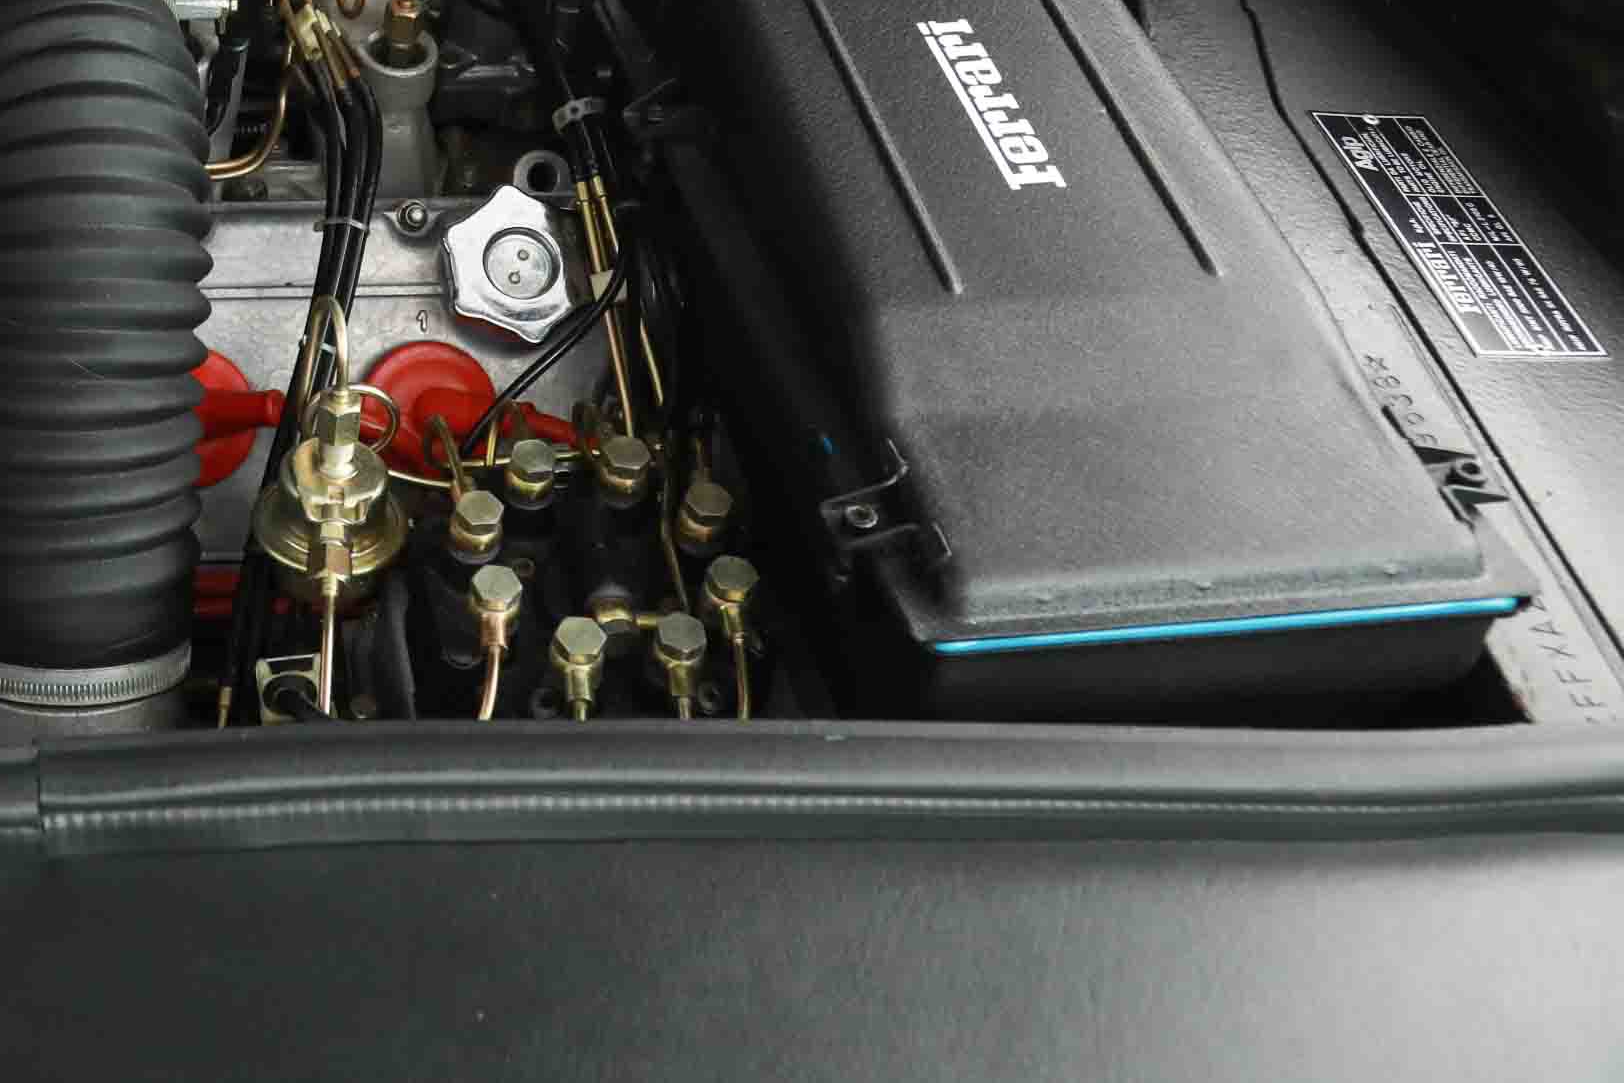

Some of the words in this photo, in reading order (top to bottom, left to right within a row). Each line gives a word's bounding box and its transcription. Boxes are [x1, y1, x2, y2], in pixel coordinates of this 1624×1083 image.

[916, 19, 1067, 190] Ferrari
[1335, 135, 1382, 171] Agip
[1411, 241, 1483, 313] Ferrari
